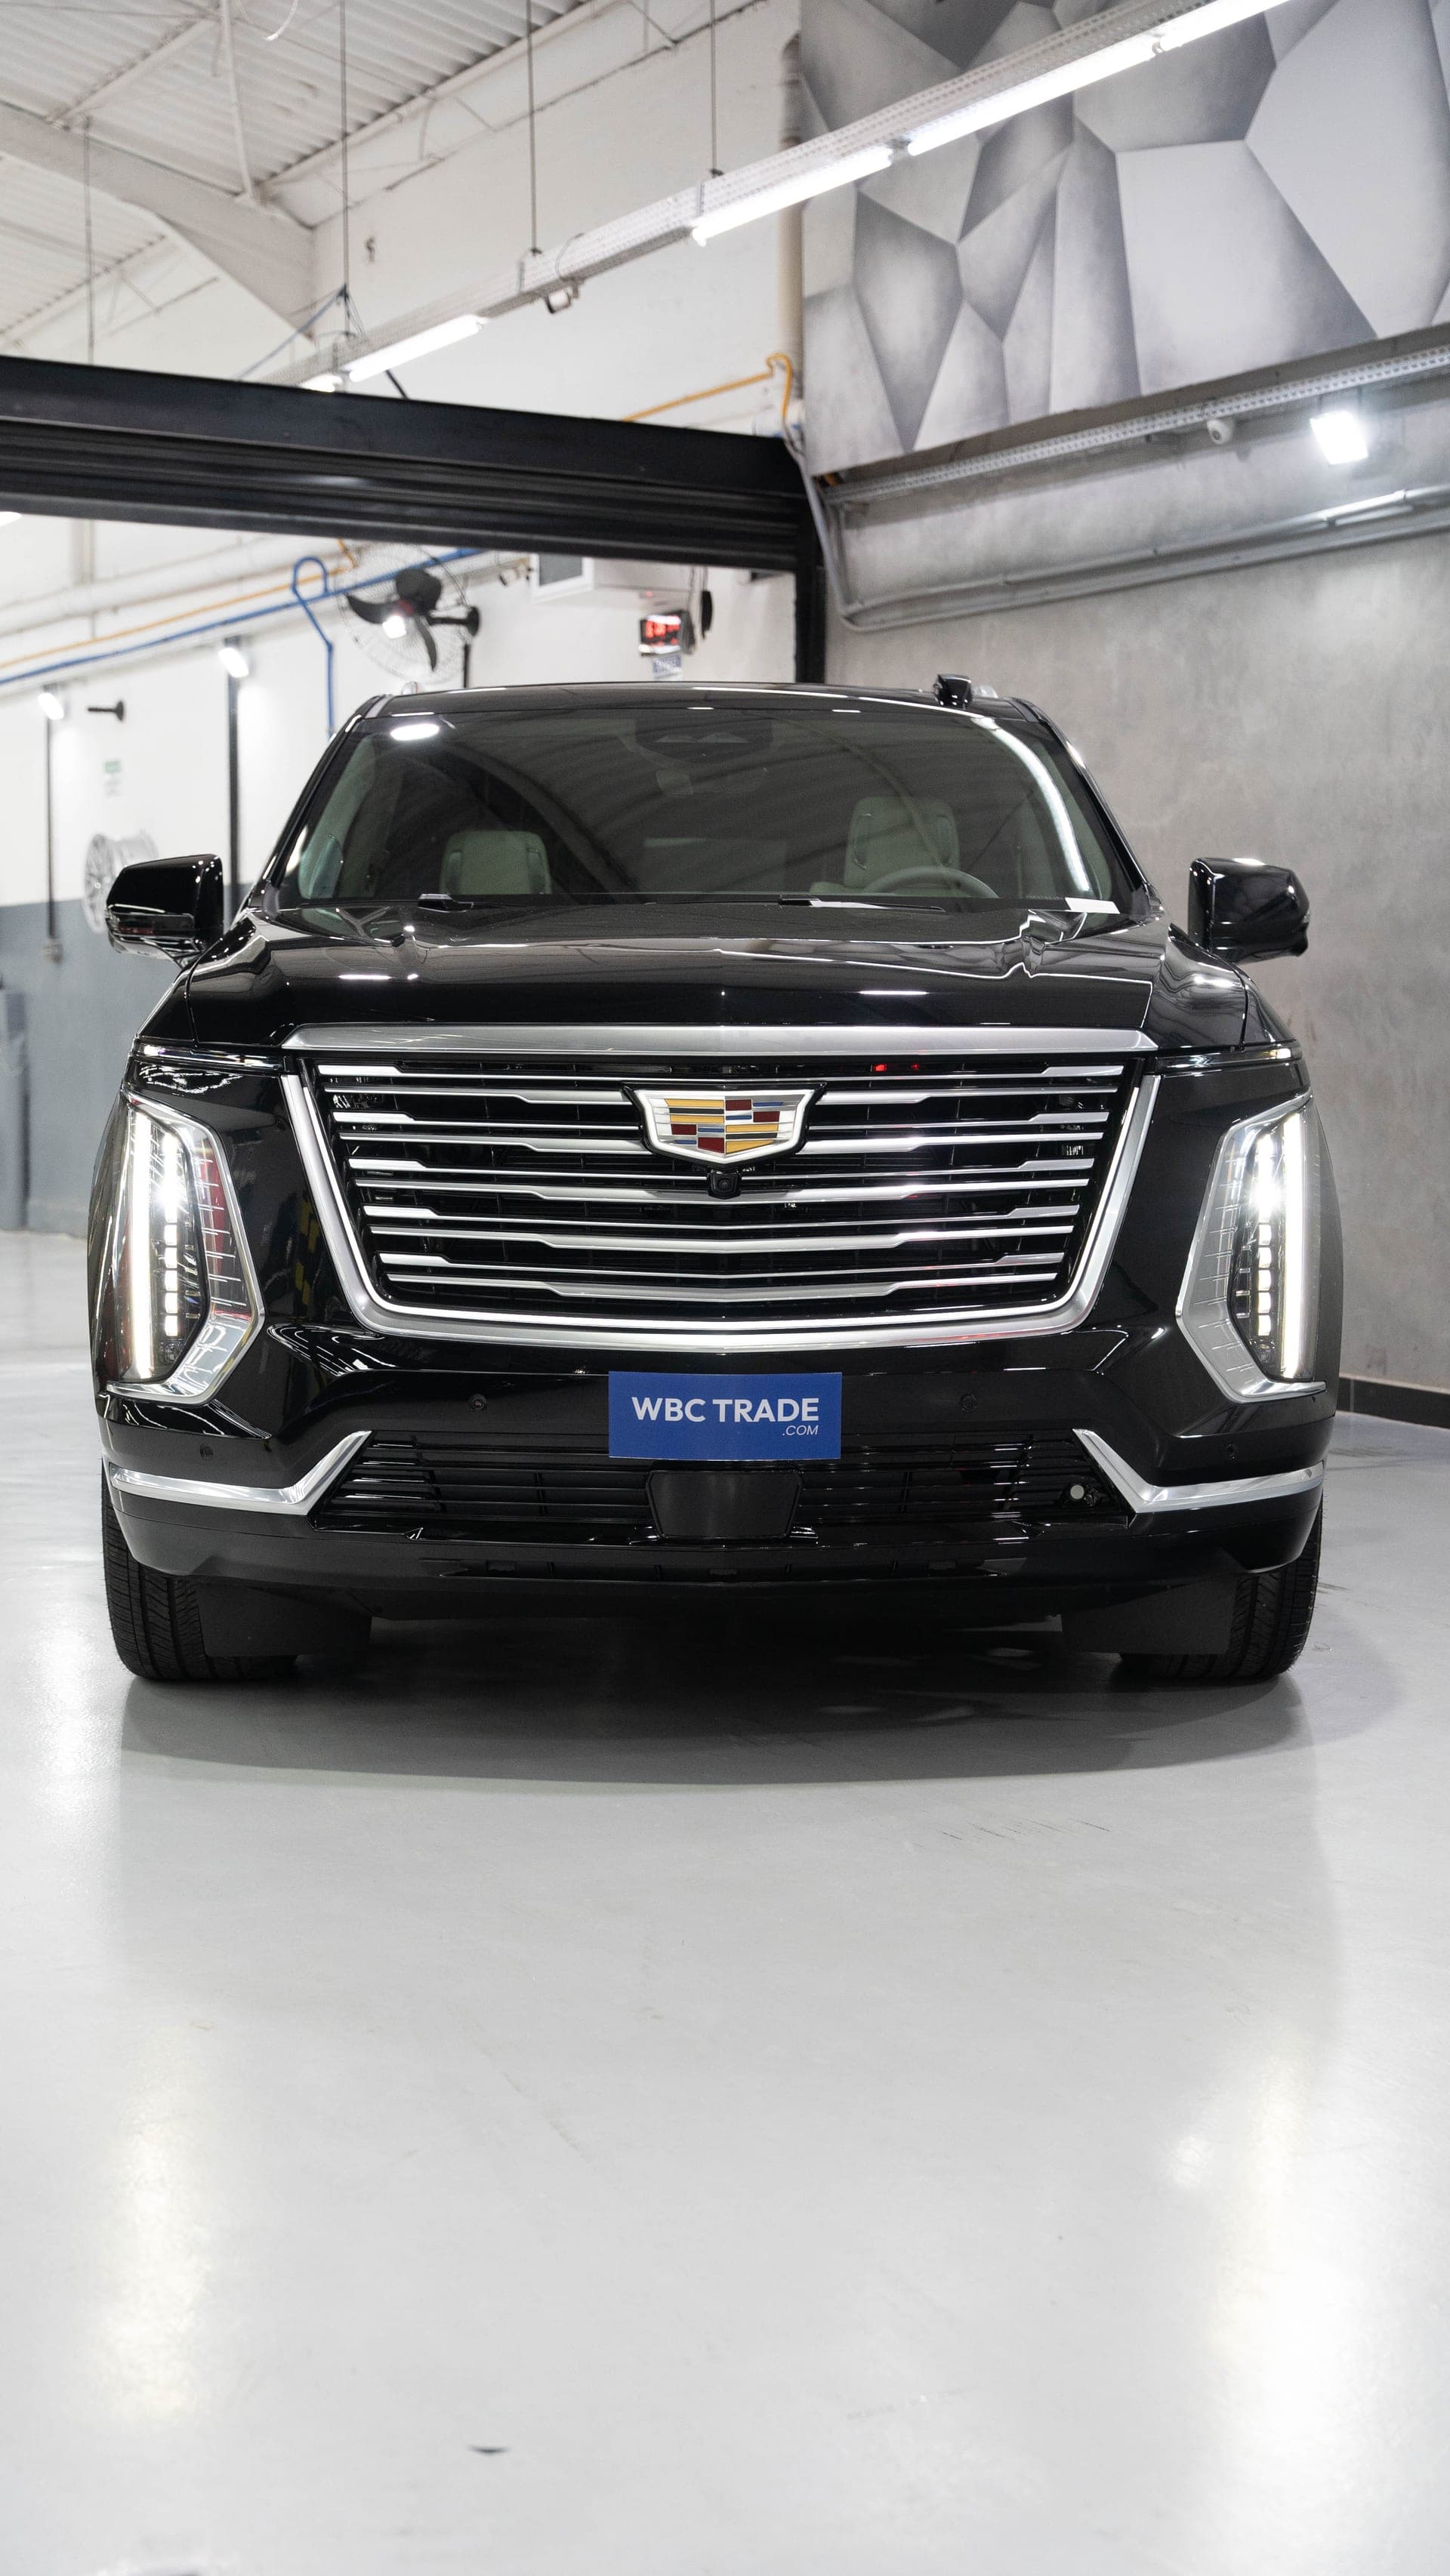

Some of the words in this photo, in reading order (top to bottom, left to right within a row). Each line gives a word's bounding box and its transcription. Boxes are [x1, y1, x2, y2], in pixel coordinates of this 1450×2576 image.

[631, 1397, 706, 1422] WBC
[712, 1397, 819, 1422] TRADE
[782, 1425, 819, 1436] .COM
